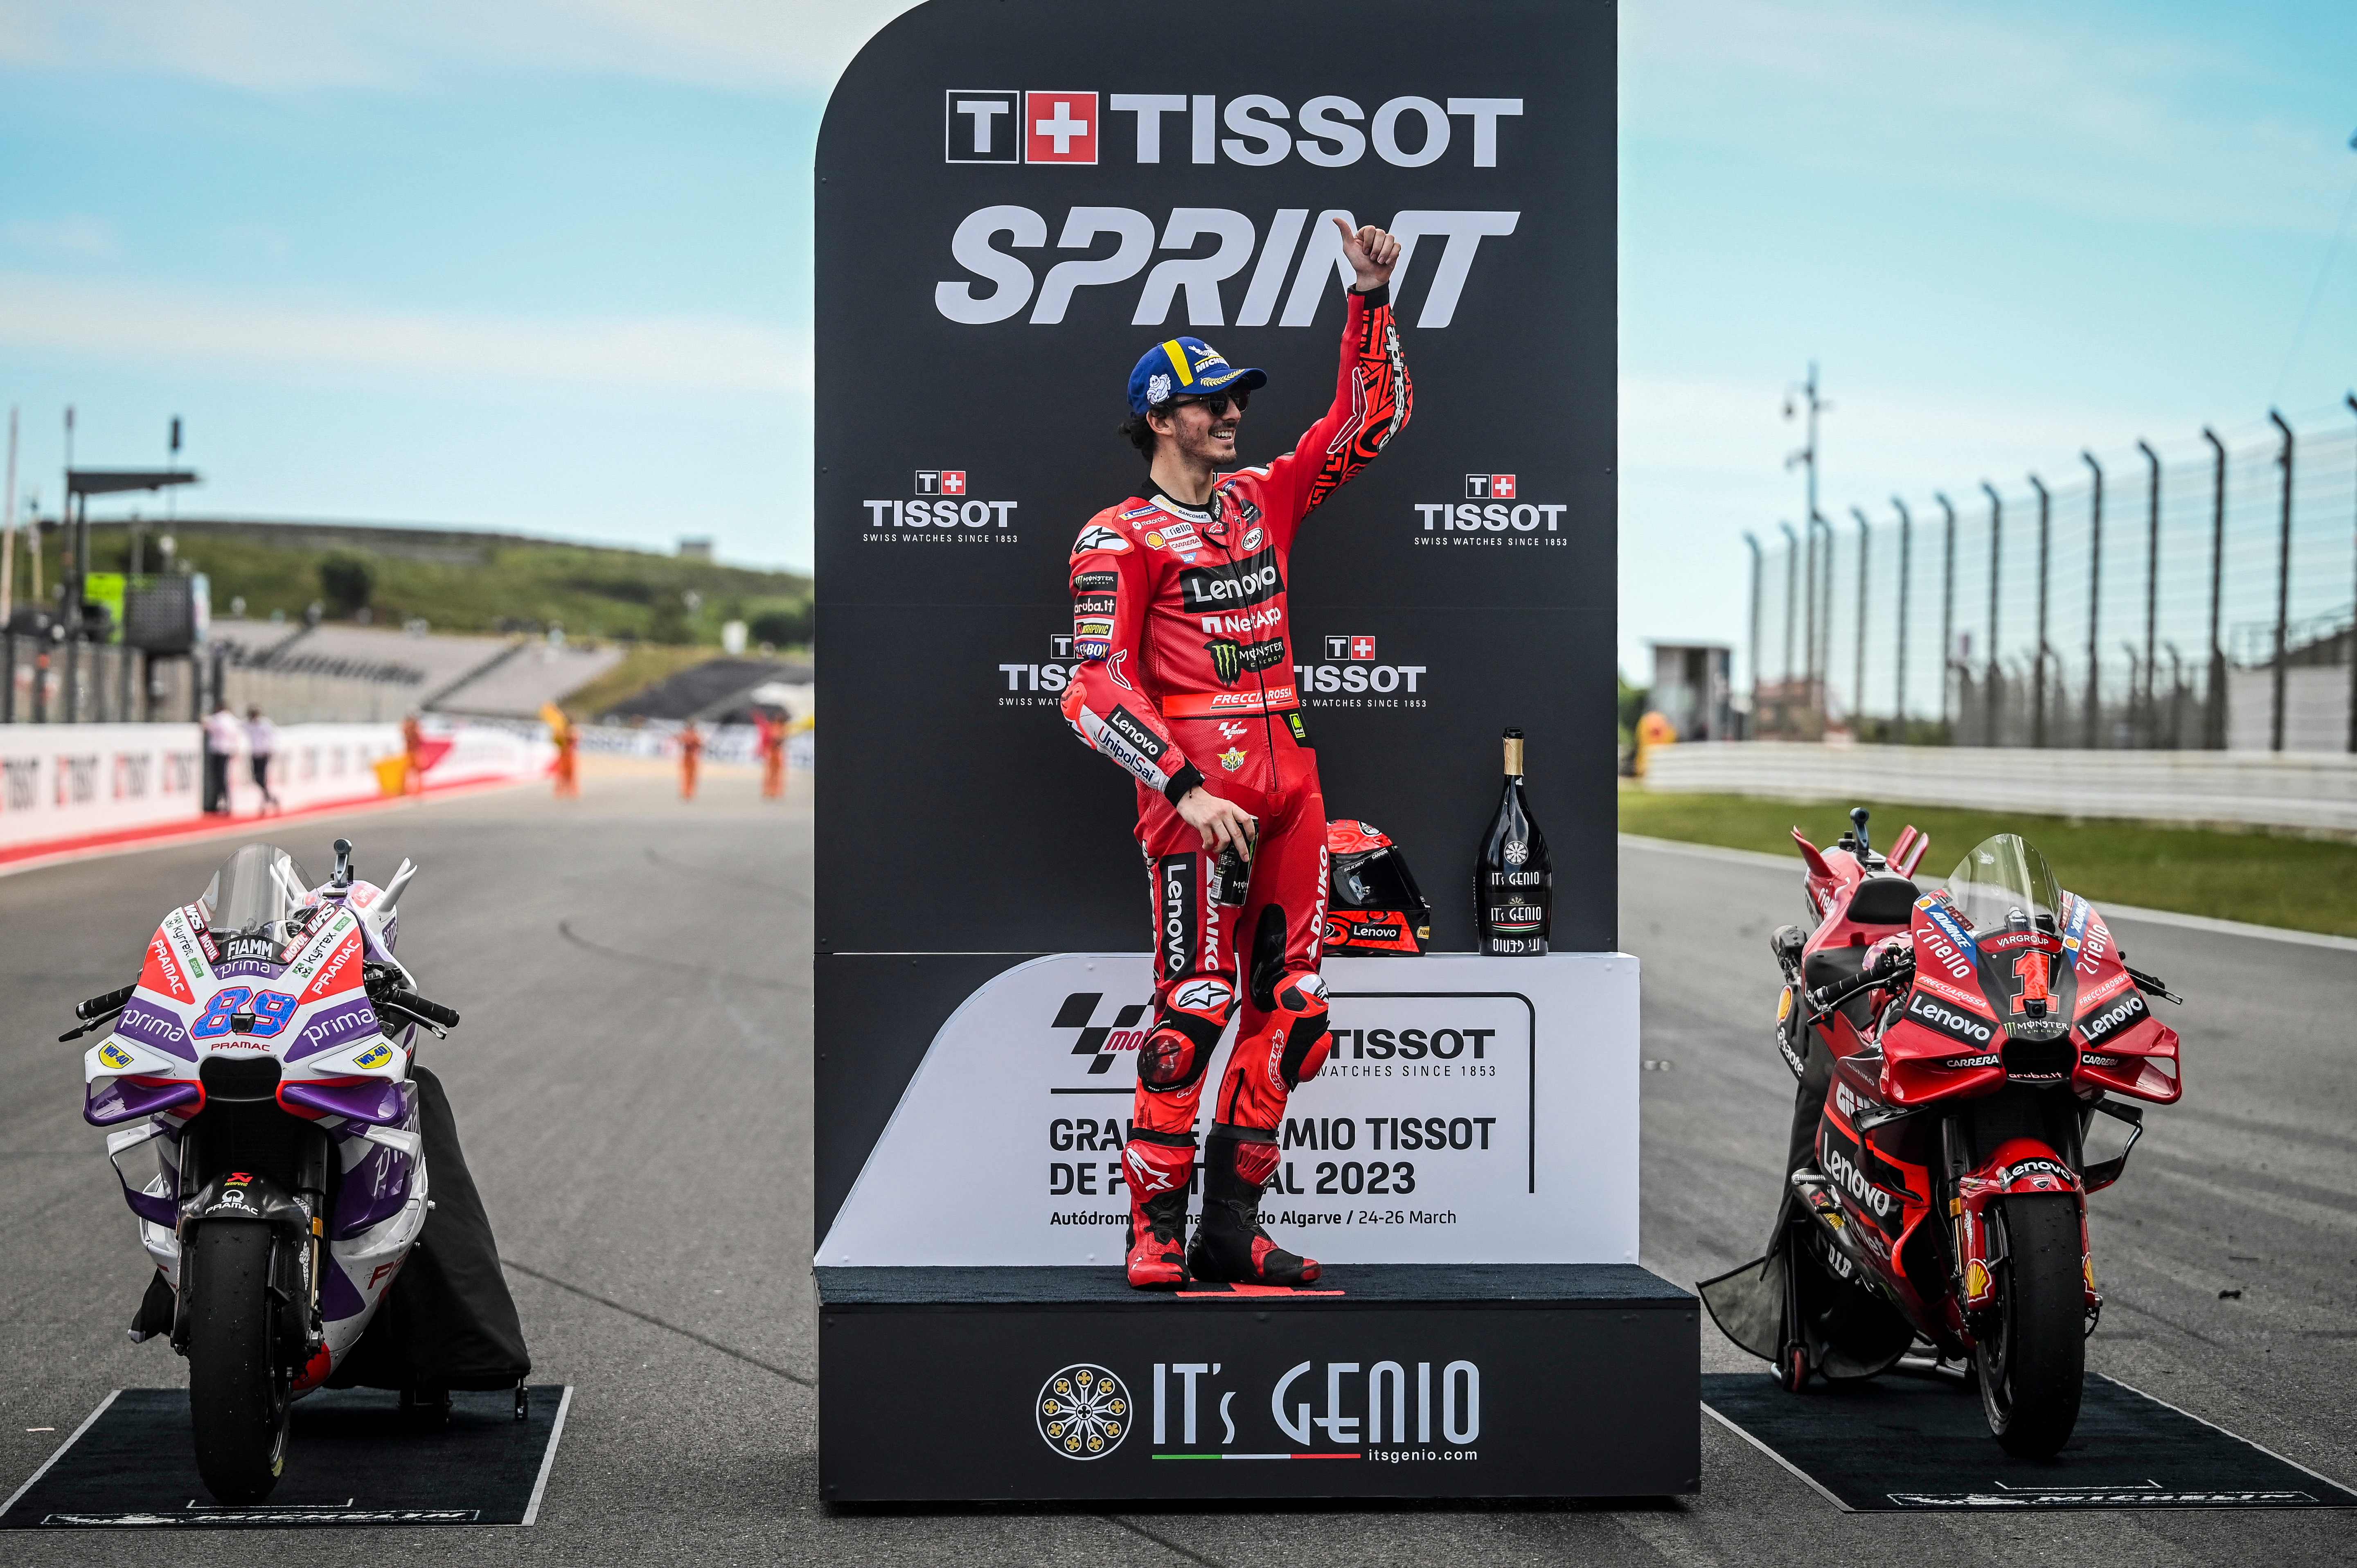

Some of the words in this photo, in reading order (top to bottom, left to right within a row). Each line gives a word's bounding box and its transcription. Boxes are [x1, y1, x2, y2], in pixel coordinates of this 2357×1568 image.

[1110, 94, 1524, 168] TISSOT
[934, 205, 1521, 328] SPRINT
[863, 500, 1018, 527] TISSOT
[1141, 516, 1168, 526] motorola
[1178, 509, 1208, 519] BANCOMAT
[1414, 503, 1567, 531] TISSOT
[863, 534, 897, 542] SWISS
[902, 534, 952, 542] WATCHES
[958, 534, 989, 542] SINCE
[995, 534, 1018, 543] 1853
[1170, 523, 1191, 536] riello
[1243, 532, 1262, 546] SUOMY
[1171, 538, 1200, 548] CARRERA
[1192, 566, 1276, 602] Lenovo
[1074, 597, 1115, 613] aruba.it
[1225, 607, 1281, 633] NetApp
[1239, 641, 1283, 661] MONSTER
[1293, 665, 1426, 693] ISSOT
[998, 698, 1032, 706] SWISS
[1211, 687, 1293, 705] FRECCIROSSA
[1312, 699, 1361, 707] WATCHES
[1111, 711, 1158, 755] Lenovo
[1097, 725, 1156, 782] UnipolSai
[1344, 860, 1365, 872] SUOMY
[1509, 872, 1539, 885] GENIO
[184, 903, 205, 930] WRS
[307, 903, 336, 934] WRS
[1167, 864, 1187, 972] Lenovo
[1509, 907, 1541, 921] GENIO
[1353, 925, 1397, 937] Lenovo
[1996, 935, 2049, 947] VARGROUP
[199, 933, 218, 960] MOTUL
[227, 939, 273, 958] FIAMM
[283, 935, 308, 962] MOTUL
[1922, 933, 1970, 978] riello
[2082, 924, 2109, 966] riello
[151, 939, 185, 995] PRAMAC
[191, 960, 201, 975] SPORT
[219, 960, 270, 978] prima
[313, 939, 361, 995] PRAMAC
[1918, 976, 1987, 1008] FRECCIAROSSA
[2010, 950, 2059, 1016] 1
[2079, 973, 2128, 1006] FRECCIAROSSA
[120, 1009, 185, 1042] prima
[189, 986, 300, 1039] 89
[1910, 995, 1990, 1041] Lenovo
[2017, 1020, 2069, 1031] MONSTER
[2079, 997, 2143, 1041] Lenovo
[303, 1007, 374, 1047] prima
[104, 1044, 130, 1066] WD-40
[211, 1041, 271, 1052] PRAMAC
[357, 1046, 390, 1067] WD-40
[1329, 1028, 1496, 1060] TISSOT
[1316, 1065, 1393, 1077] WATCHES
[1402, 1065, 1451, 1077] SINCE
[1461, 1065, 1496, 1077] 1853
[1947, 1054, 1999, 1067] CARRERA
[2082, 1054, 2119, 1066] CARRERA
[1365, 1117, 1496, 1150] TISSOT
[1050, 1162, 1097, 1195] DE
[1315, 1161, 1416, 1195] 2023
[1824, 1131, 1890, 1217] Lenovo
[2002, 1161, 2071, 1185] Lenovo
[205, 1202, 259, 1216] PRAMAC
[1050, 1210, 1129, 1226] Autódrom
[1257, 1210, 1276, 1224] do
[1280, 1210, 1342, 1228] Algarve
[1358, 1210, 1404, 1225] 24-26
[1409, 1209, 1457, 1225] March
[1154, 1363, 1236, 1444] IT's
[1271, 1360, 1479, 1446] GENIO
[1368, 1448, 1478, 1463] itsgenio.com
